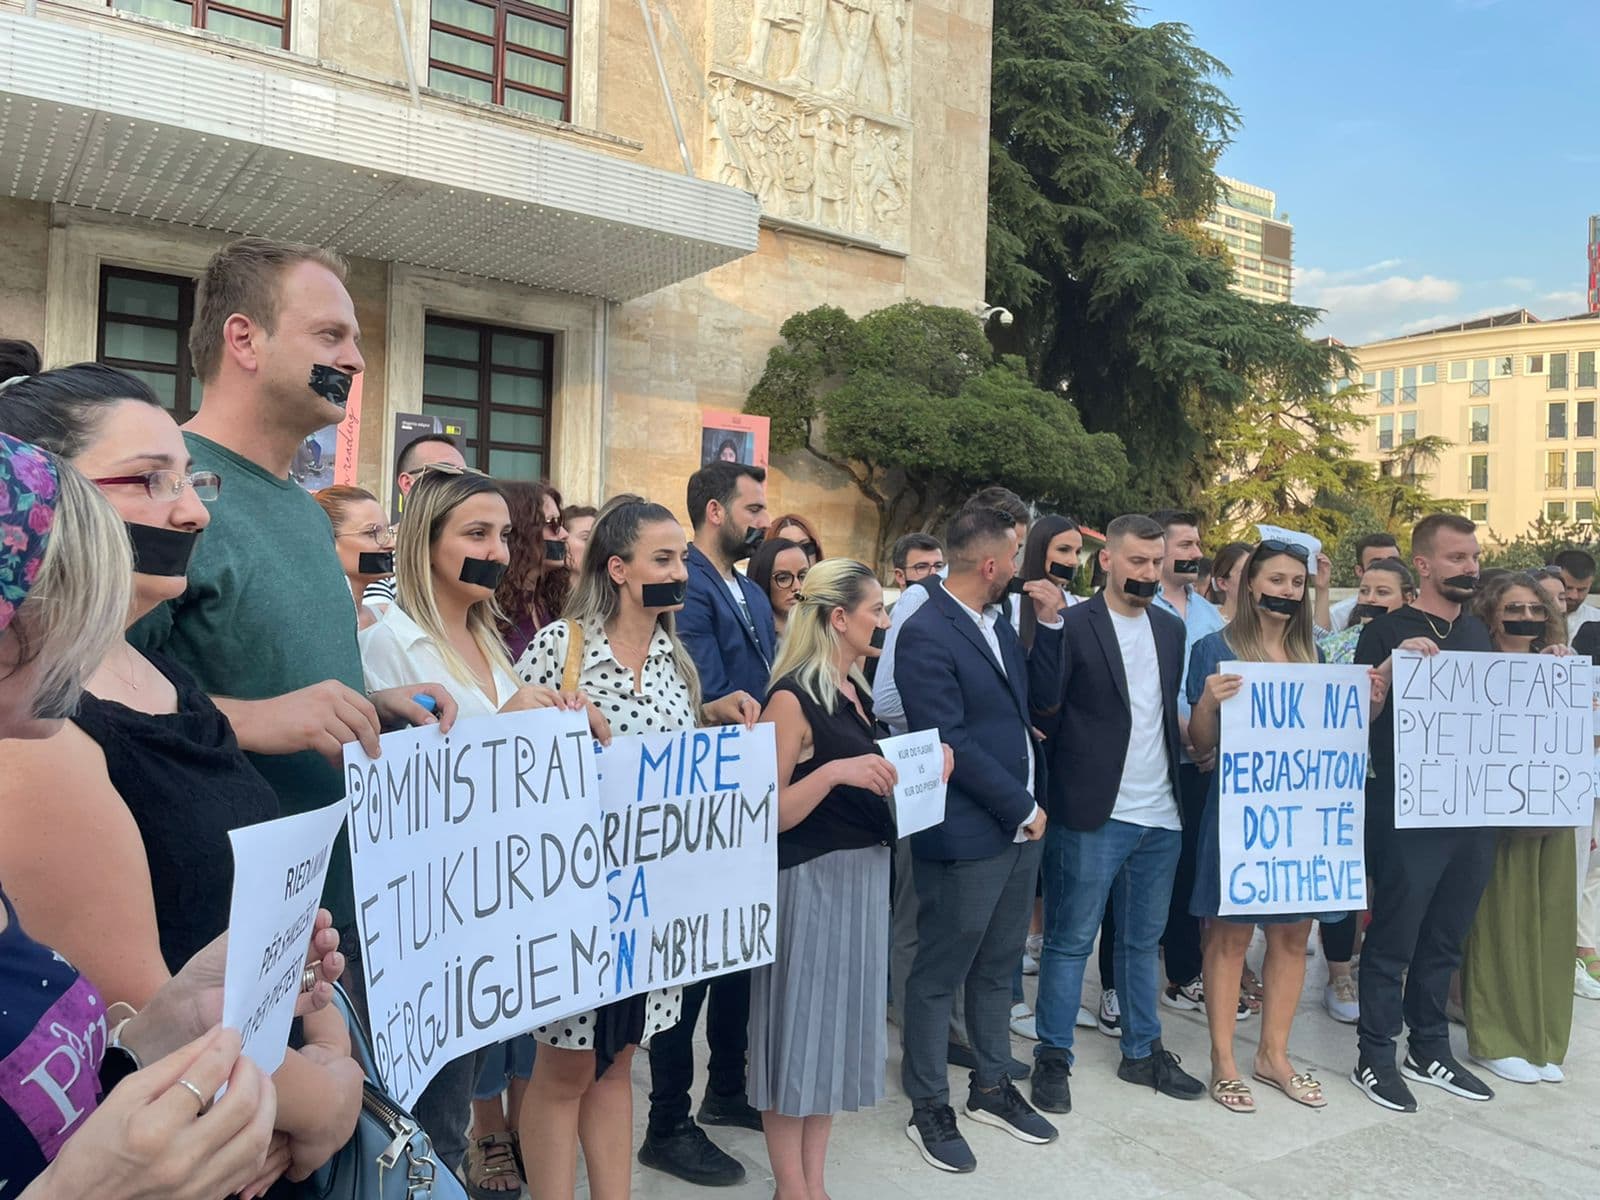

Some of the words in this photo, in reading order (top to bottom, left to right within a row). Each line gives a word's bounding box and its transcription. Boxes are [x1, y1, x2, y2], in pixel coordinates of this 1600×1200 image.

[1250, 681, 1305, 729] NUK
[1323, 683, 1363, 729] NA
[637, 726, 740, 801] MIRË
[1222, 749, 1365, 794] PERJASHTON
[1243, 804, 1303, 851] DOT
[1315, 801, 1355, 846] TË
[1228, 855, 1363, 905] GJITHËVE
[648, 902, 773, 984] MBYLLUR
